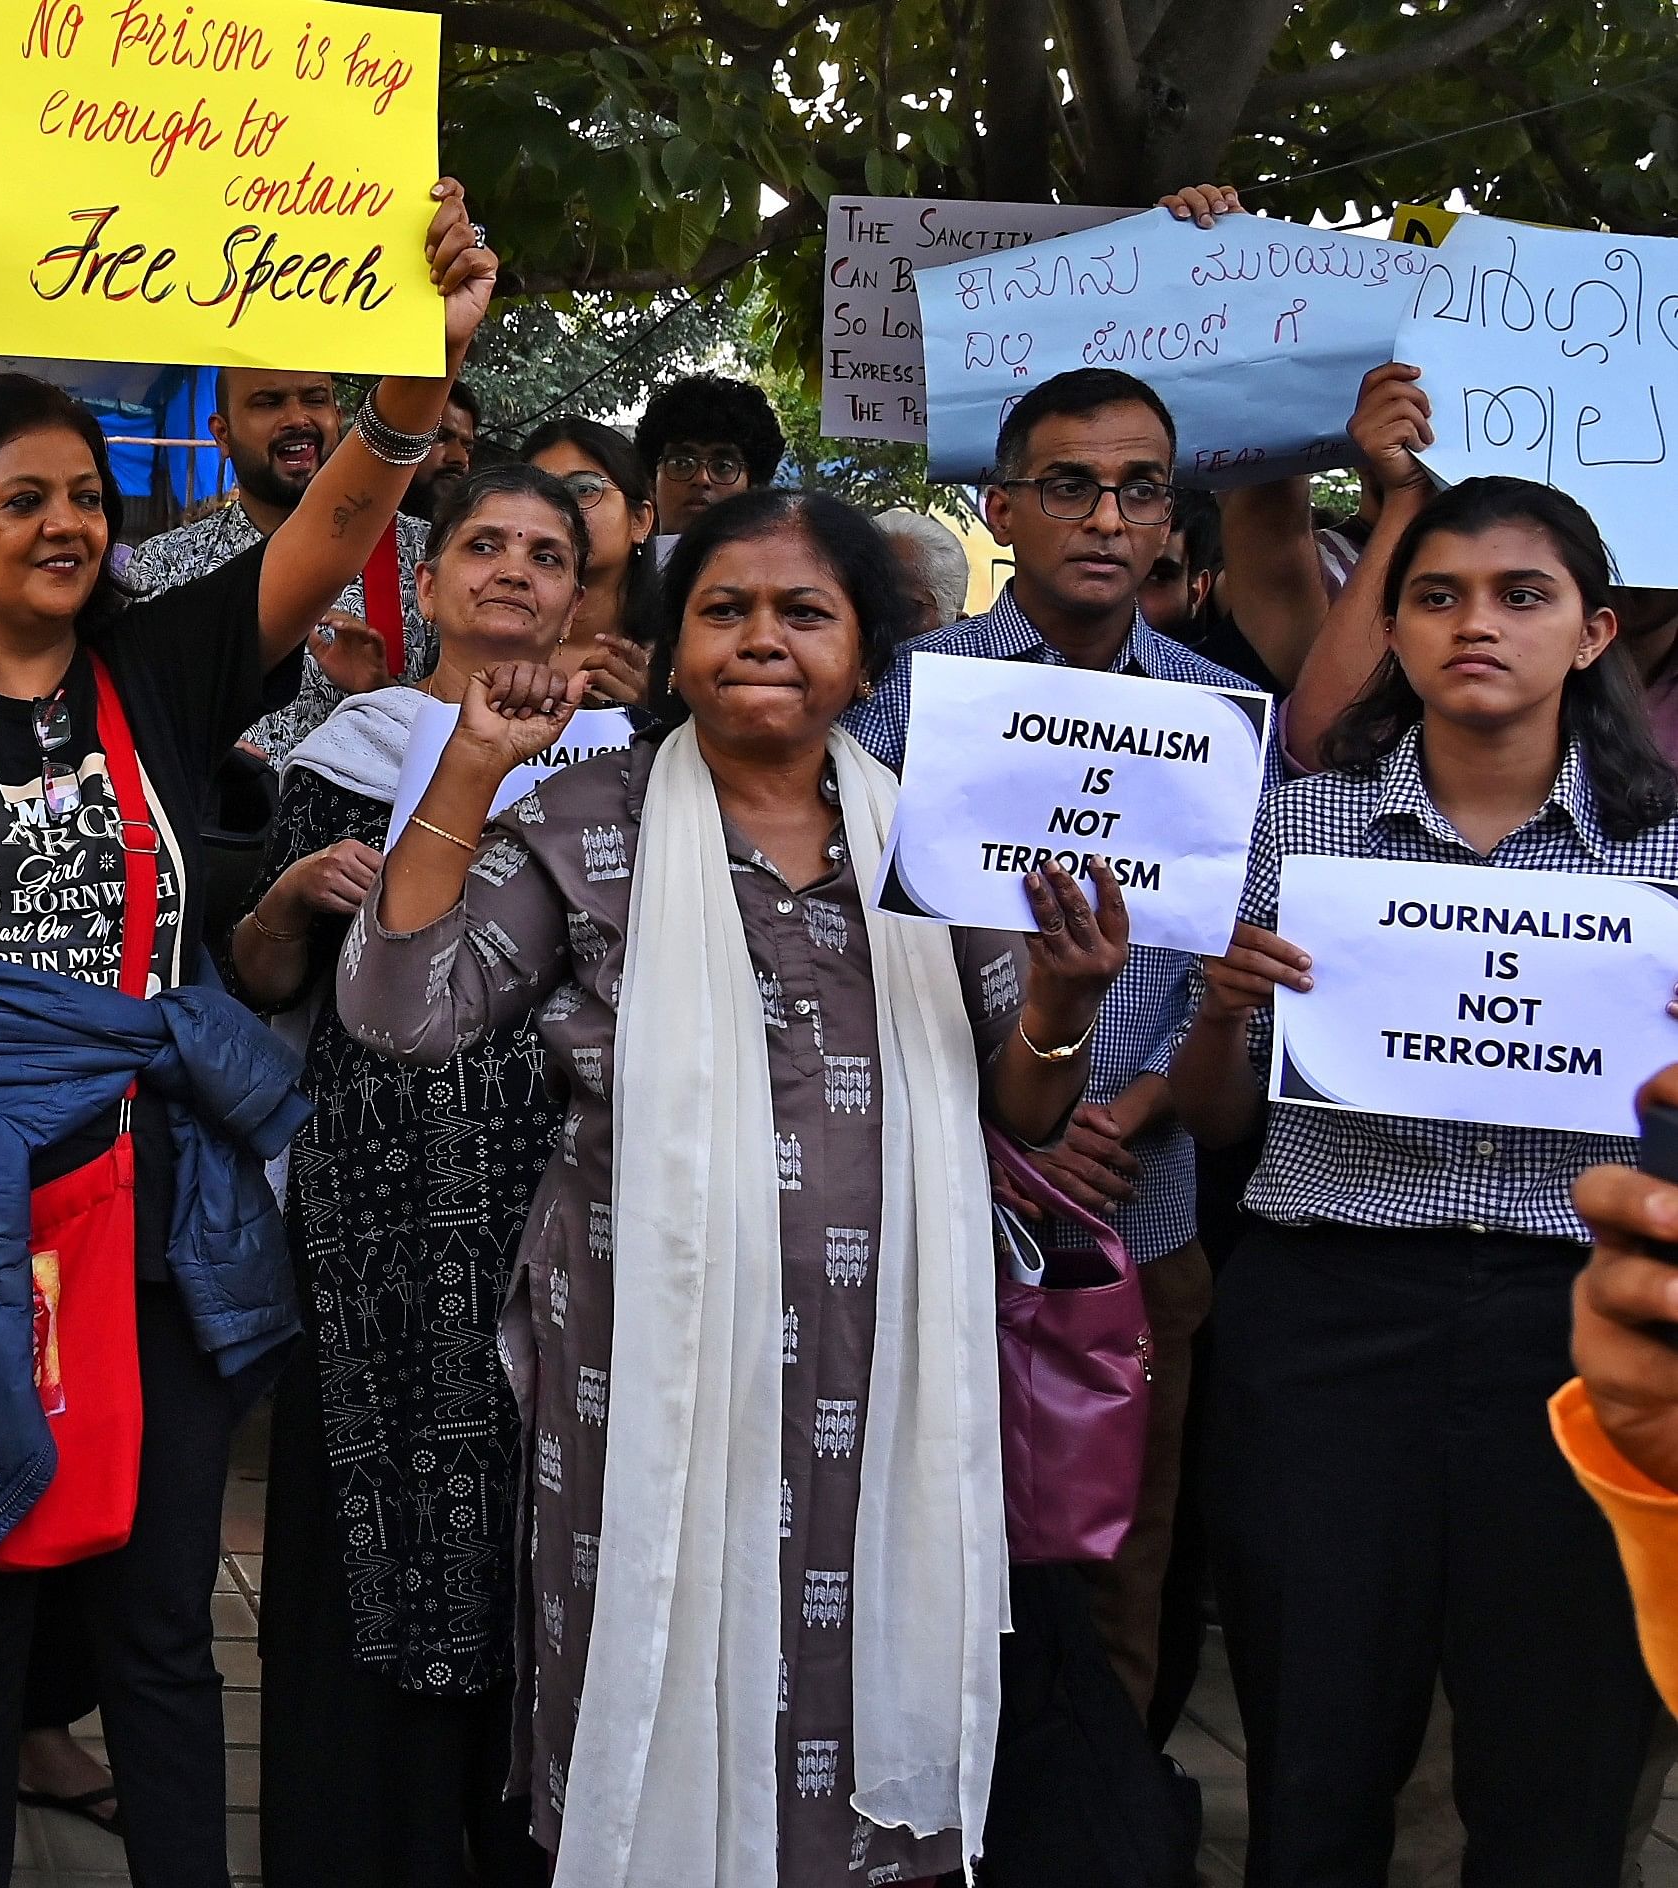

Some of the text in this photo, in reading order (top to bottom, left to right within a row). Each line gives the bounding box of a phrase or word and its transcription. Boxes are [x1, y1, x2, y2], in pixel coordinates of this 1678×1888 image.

[22, 0, 84, 59] No
[295, 23, 331, 80] is
[345, 32, 415, 116] big
[40, 89, 289, 178] enough to
[224, 161, 394, 217] contain
[839, 205, 894, 244] THE
[30, 205, 397, 329] Free Speech
[830, 256, 878, 289] CAN
[844, 394, 884, 421] THE
[1002, 711, 1210, 764] JOURNALISM
[1081, 766, 1114, 795] IS
[1047, 807, 1121, 840] NOT
[16, 850, 87, 895] Girl
[11, 883, 91, 914] BORN
[37, 914, 74, 943] On
[1379, 900, 1632, 944] JOURNALISM
[1485, 951, 1519, 979] IS
[1458, 993, 1542, 1026] NOT
[1381, 1030, 1602, 1076] TERRORISM
